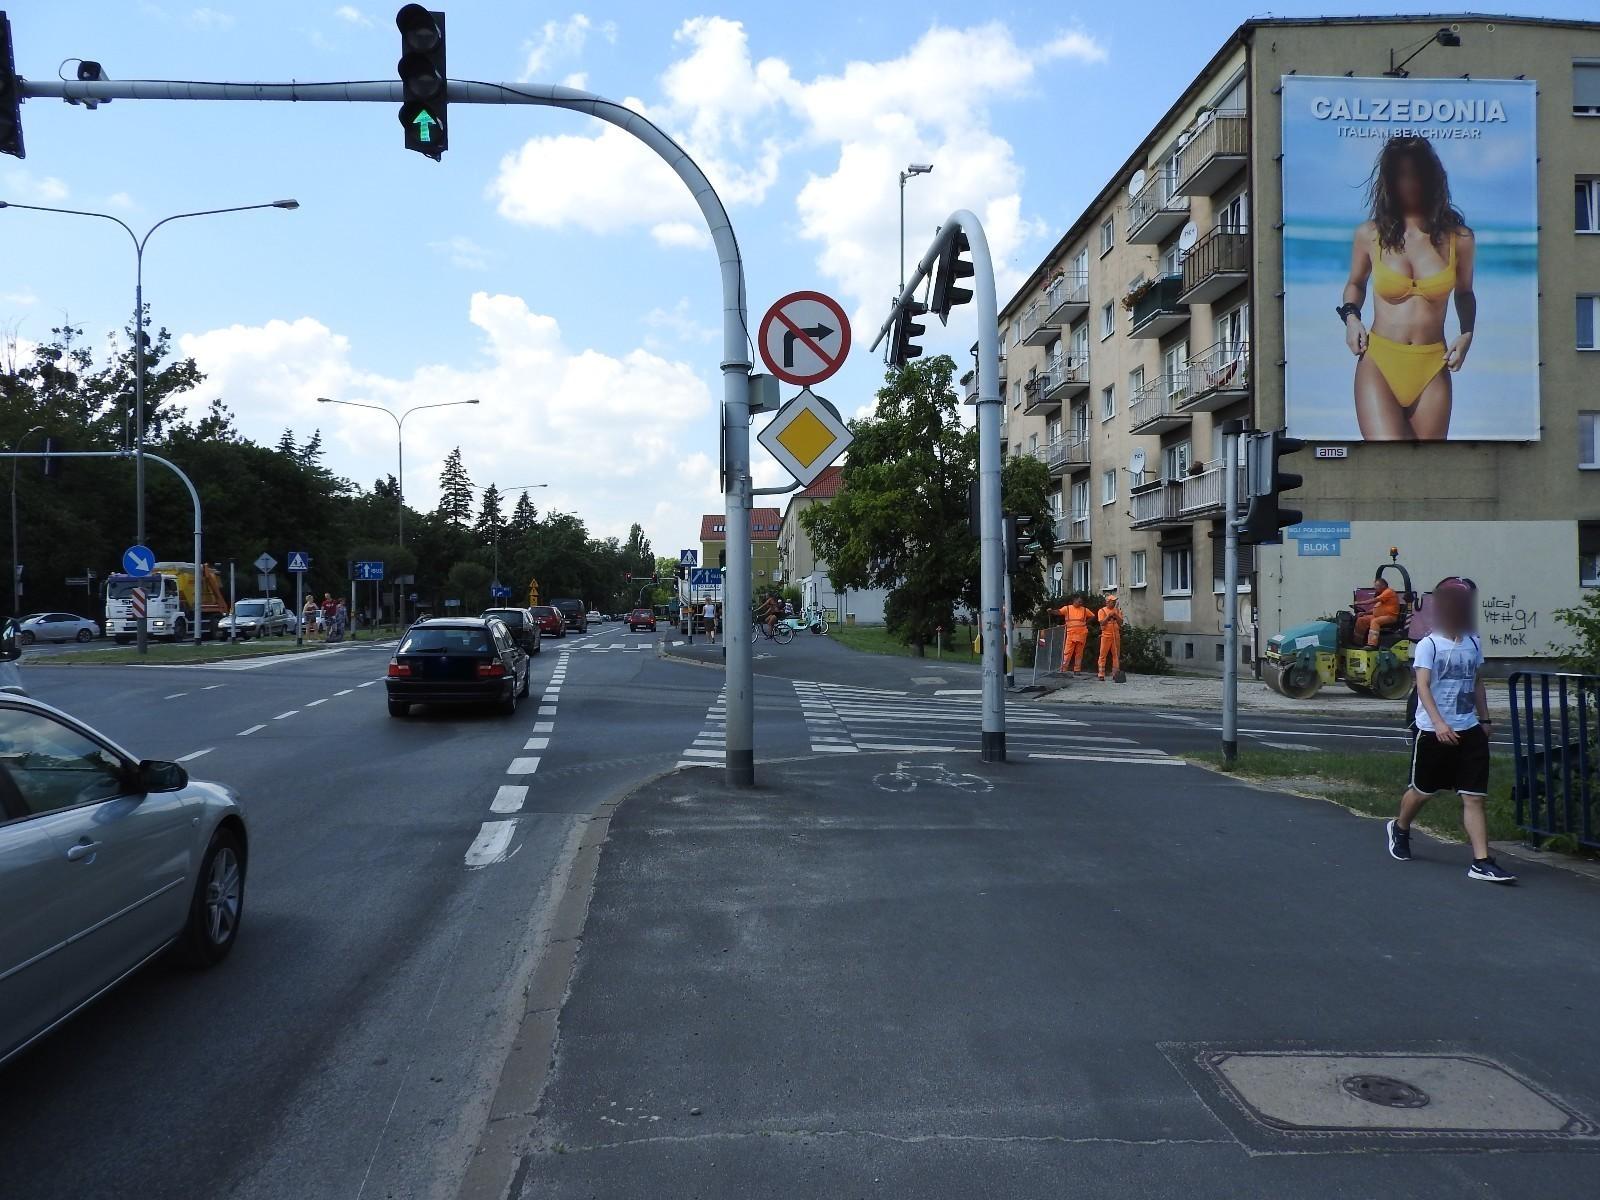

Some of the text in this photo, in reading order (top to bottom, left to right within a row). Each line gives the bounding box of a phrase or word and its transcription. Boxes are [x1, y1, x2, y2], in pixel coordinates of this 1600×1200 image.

[1310, 96, 1508, 123] CALZEDONIA
[1337, 127, 1481, 139] ITALIAN BEACHWEAR
[1319, 448, 1344, 457] ams
[1303, 543, 1336, 551] BLOK 1
